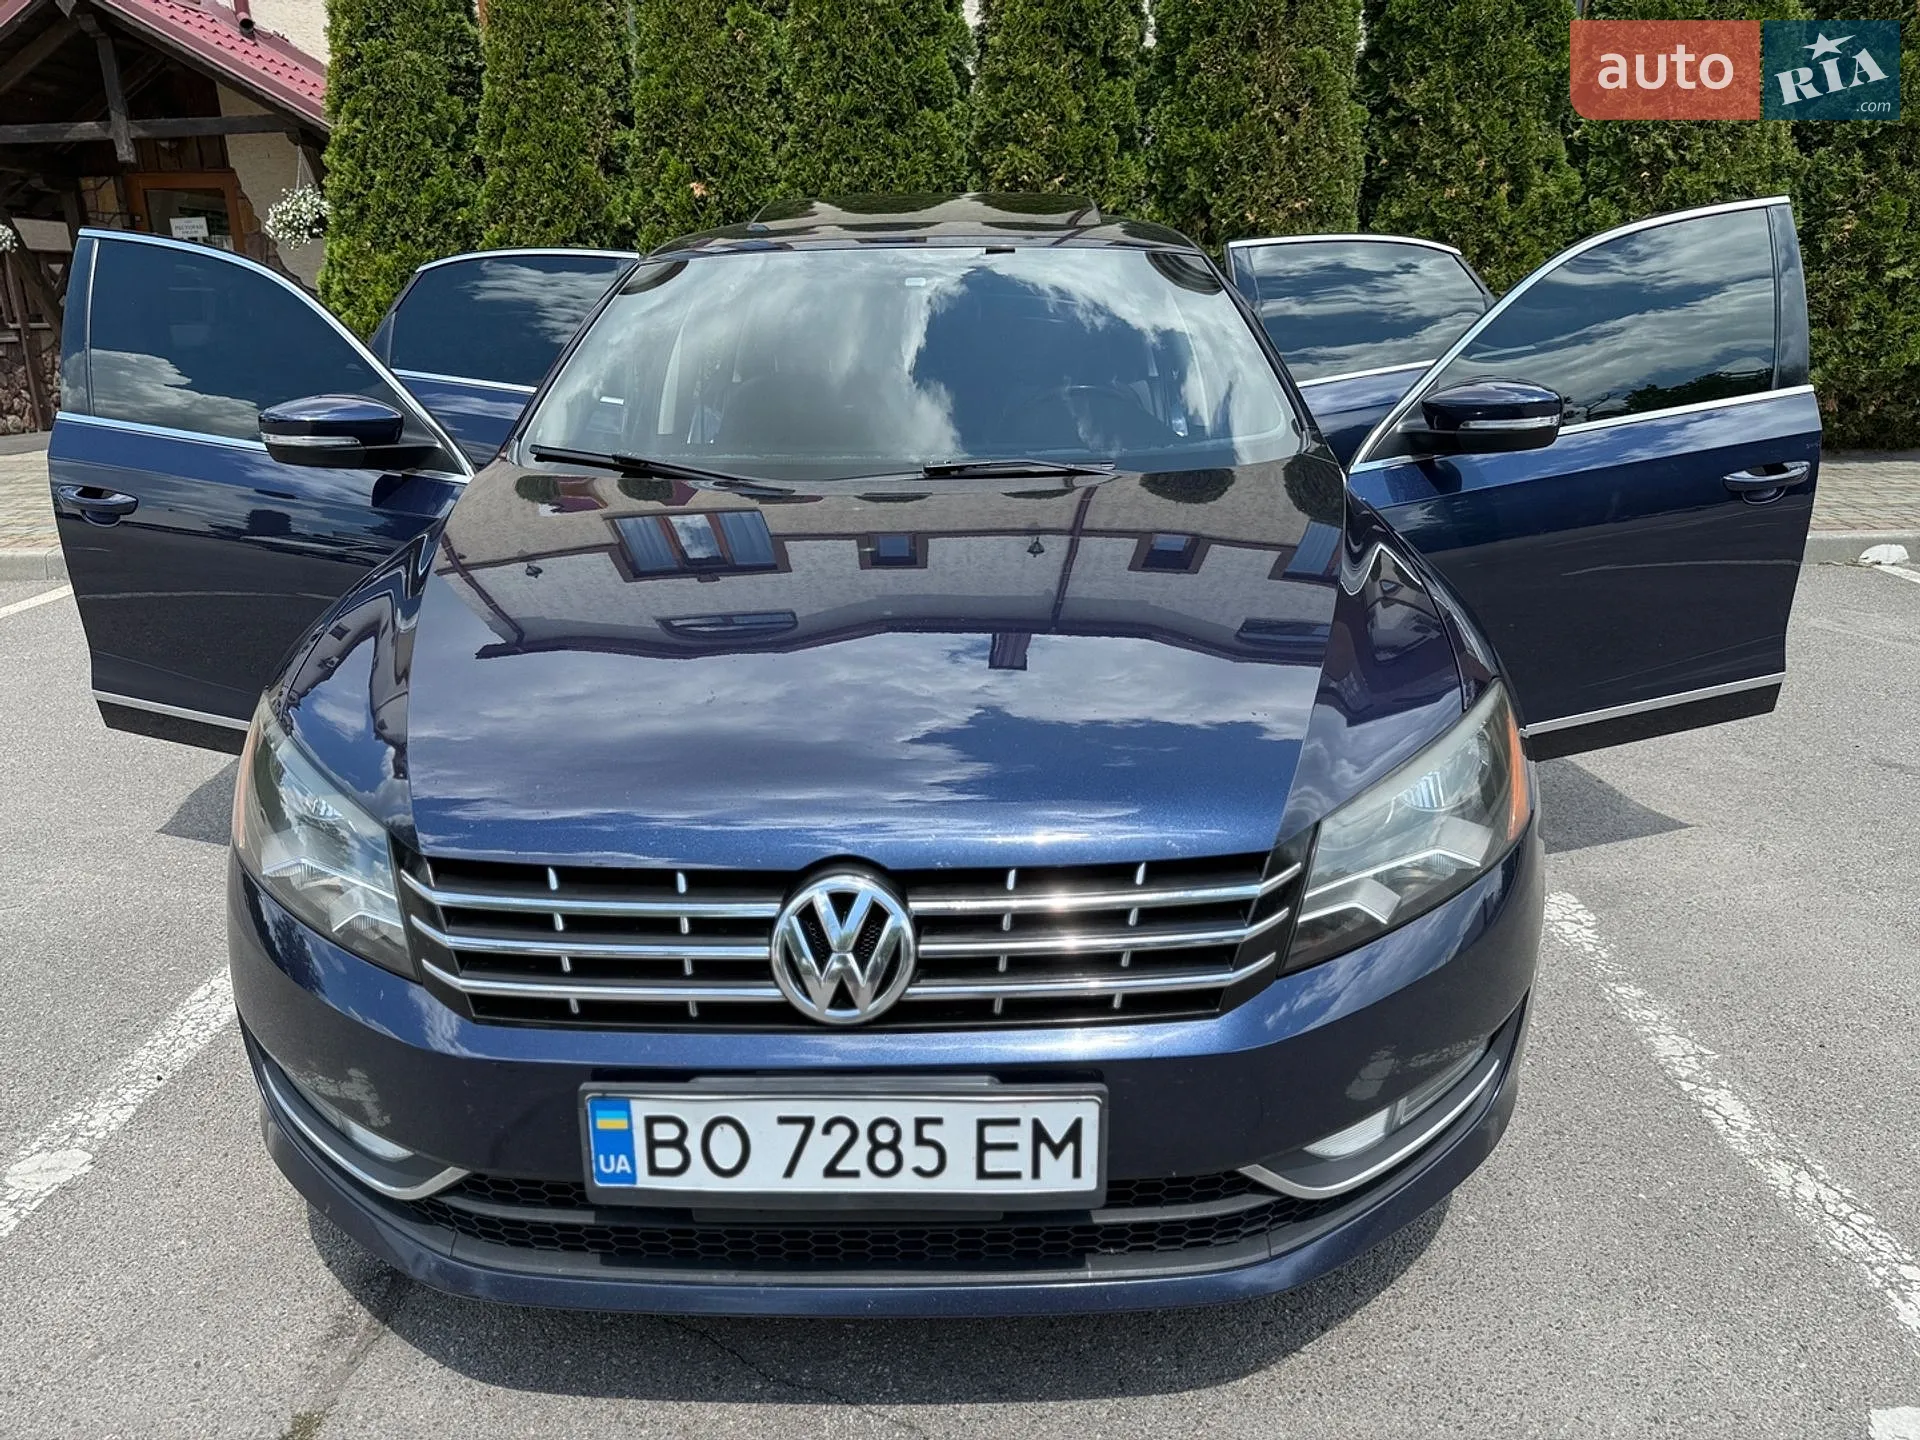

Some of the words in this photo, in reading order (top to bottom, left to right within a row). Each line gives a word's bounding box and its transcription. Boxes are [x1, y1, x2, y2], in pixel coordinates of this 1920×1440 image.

[598, 1154, 632, 1174] UA
[643, 1114, 752, 1180] BO
[776, 1115, 948, 1180] 7285
[975, 1116, 1083, 1181] EM
